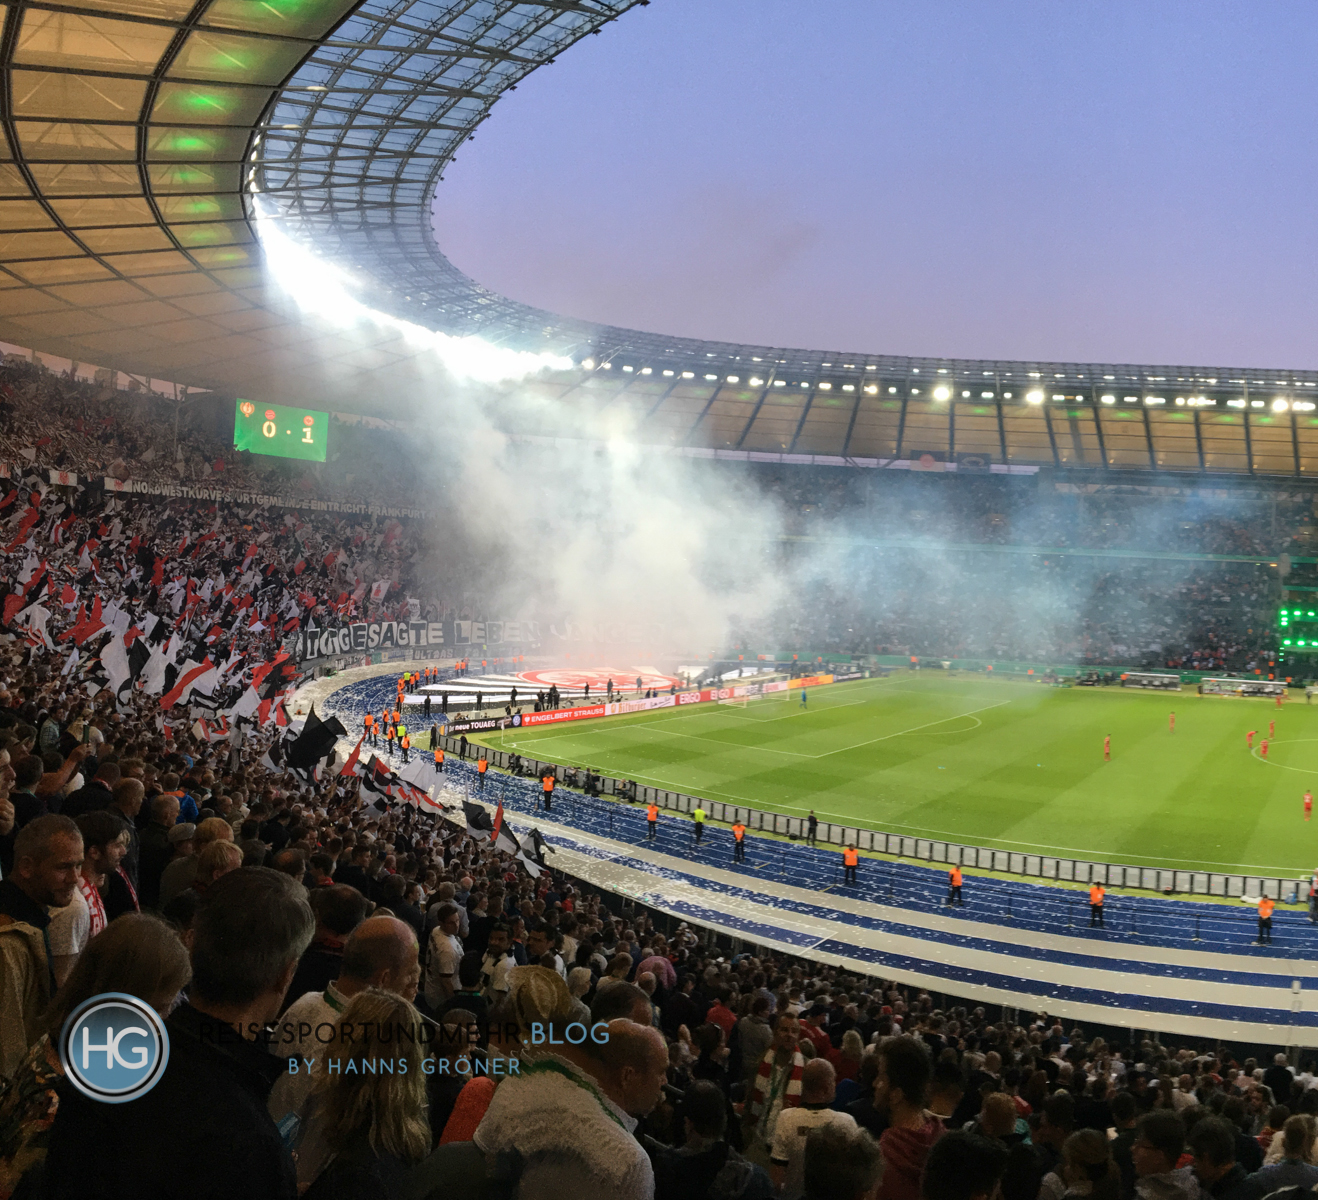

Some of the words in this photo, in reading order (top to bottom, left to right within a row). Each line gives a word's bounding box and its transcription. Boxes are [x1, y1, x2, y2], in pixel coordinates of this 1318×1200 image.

[262, 420, 277, 438] 0
[301, 427, 314, 444] 1
[680, 692, 701, 703] ERGO
[531, 712, 573, 723] ENGELBERT
[574, 707, 604, 717] STRAUSS
[455, 723, 470, 731] neue
